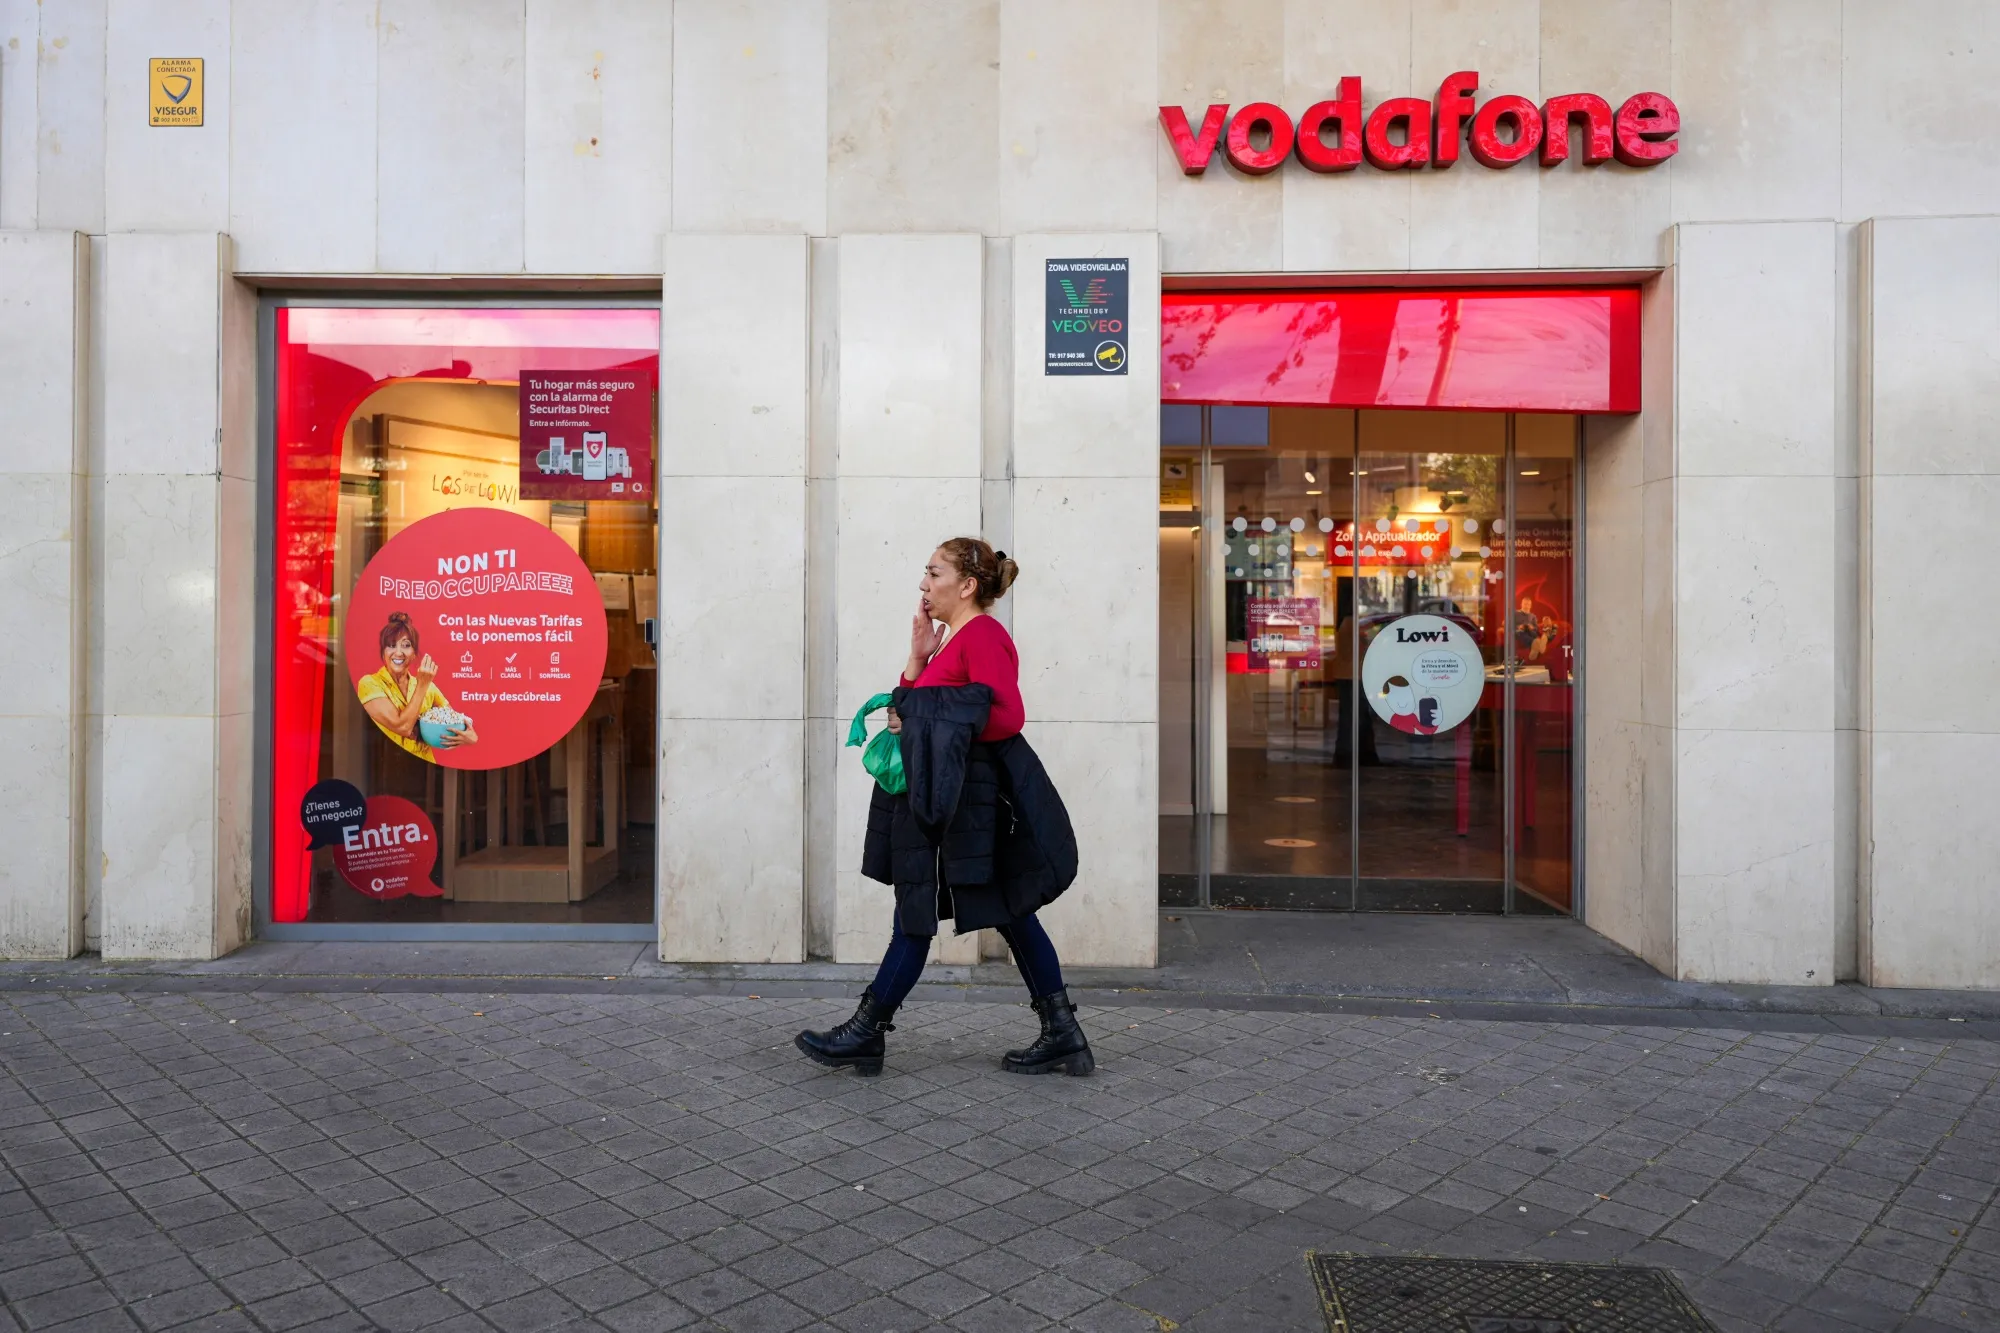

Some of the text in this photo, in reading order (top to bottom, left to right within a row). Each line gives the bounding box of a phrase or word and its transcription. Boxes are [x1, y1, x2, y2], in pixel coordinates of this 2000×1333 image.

[155, 106, 197, 115] VISEGUR
[1158, 71, 1681, 175] vodafone
[1070, 263, 1126, 271] VIDEOVIGILADA
[1052, 319, 1123, 333] VEOVEO
[529, 379, 635, 392] Tu hogar más seguro
[529, 391, 613, 402] con la alarma de
[529, 404, 610, 414] Securitas Direct
[478, 482, 517, 505] LOWI
[1365, 530, 1441, 544] Apptualizador
[1530, 549, 1538, 557] la
[1540, 549, 1566, 559] mejor
[437, 549, 516, 576] NON TI
[438, 614, 583, 627] Con las Nuevas Tarifas
[450, 629, 573, 645] te lo ponemos fácil
[1396, 625, 1449, 643] Lowi
[461, 691, 561, 703] Entra y descúbrelas
[305, 800, 341, 814] ¿Tienes
[306, 806, 363, 823] un negocio?
[342, 822, 429, 852] Entra.
